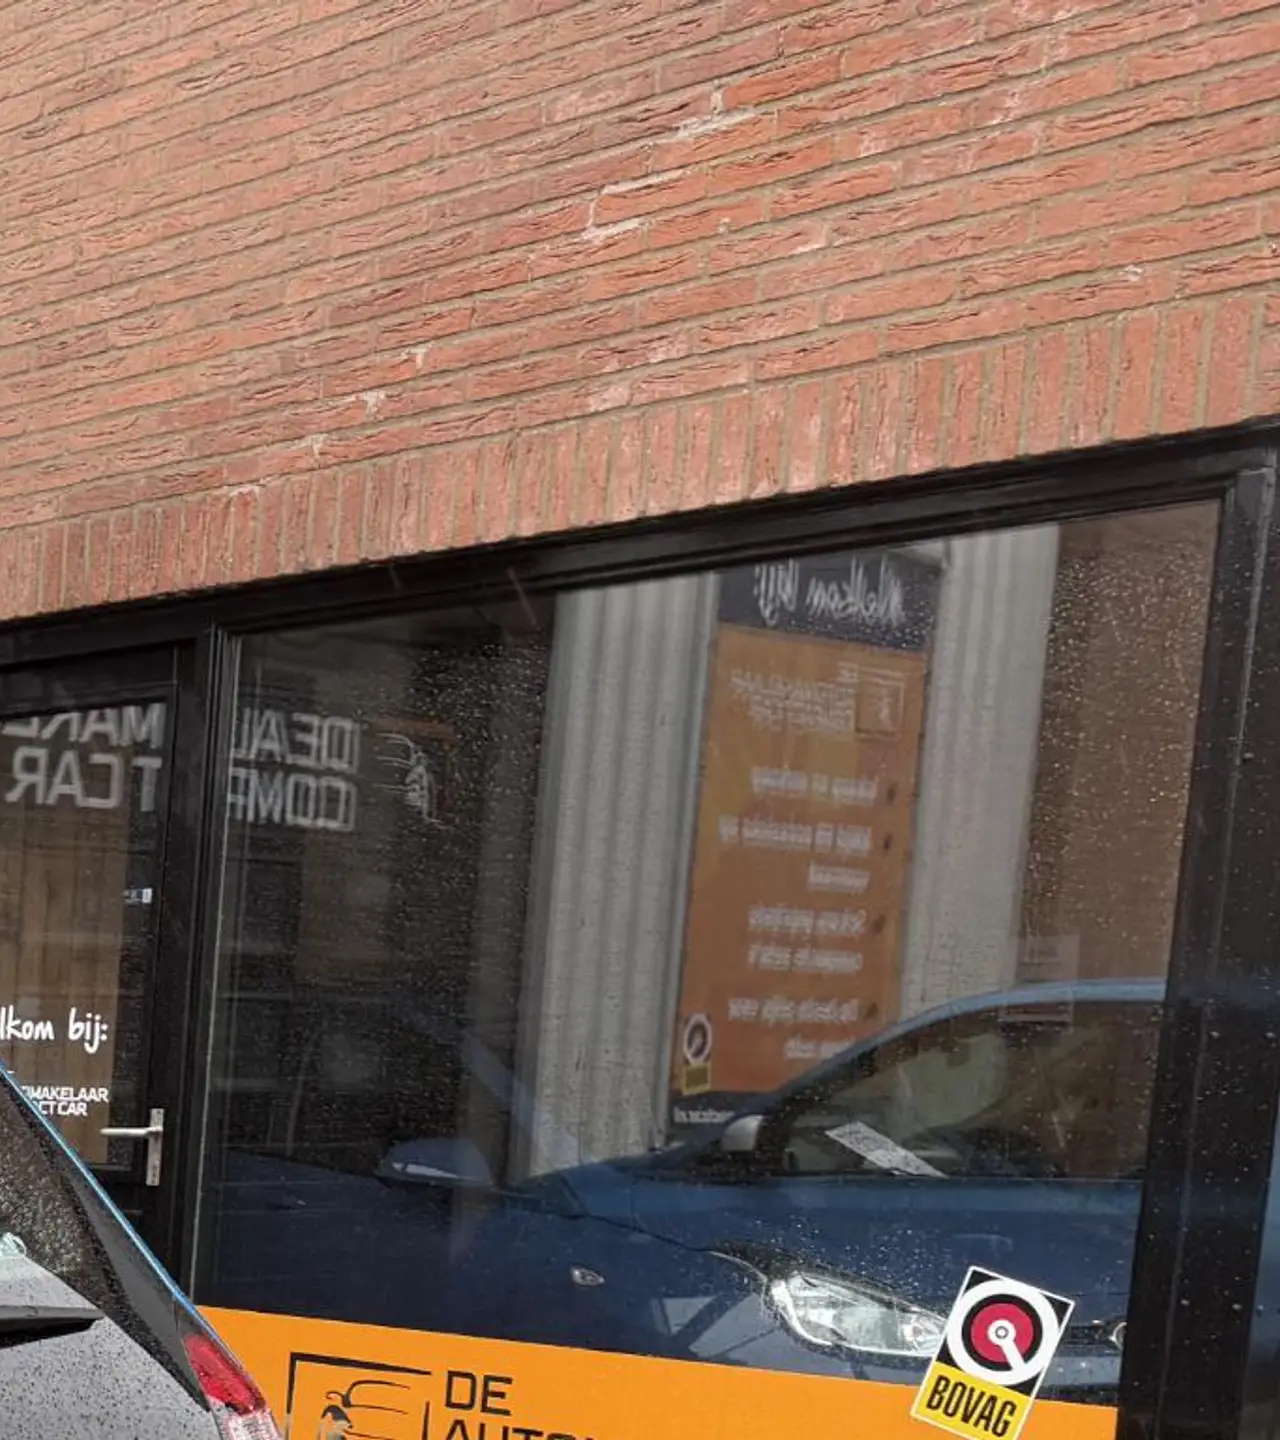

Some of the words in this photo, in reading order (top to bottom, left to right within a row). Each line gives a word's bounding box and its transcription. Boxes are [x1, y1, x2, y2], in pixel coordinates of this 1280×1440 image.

[68, 1006, 109, 1054] bij:
[57, 1101, 88, 1117] CAR
[445, 1369, 514, 1417] DE
[925, 1374, 1018, 1438] BOVAG
